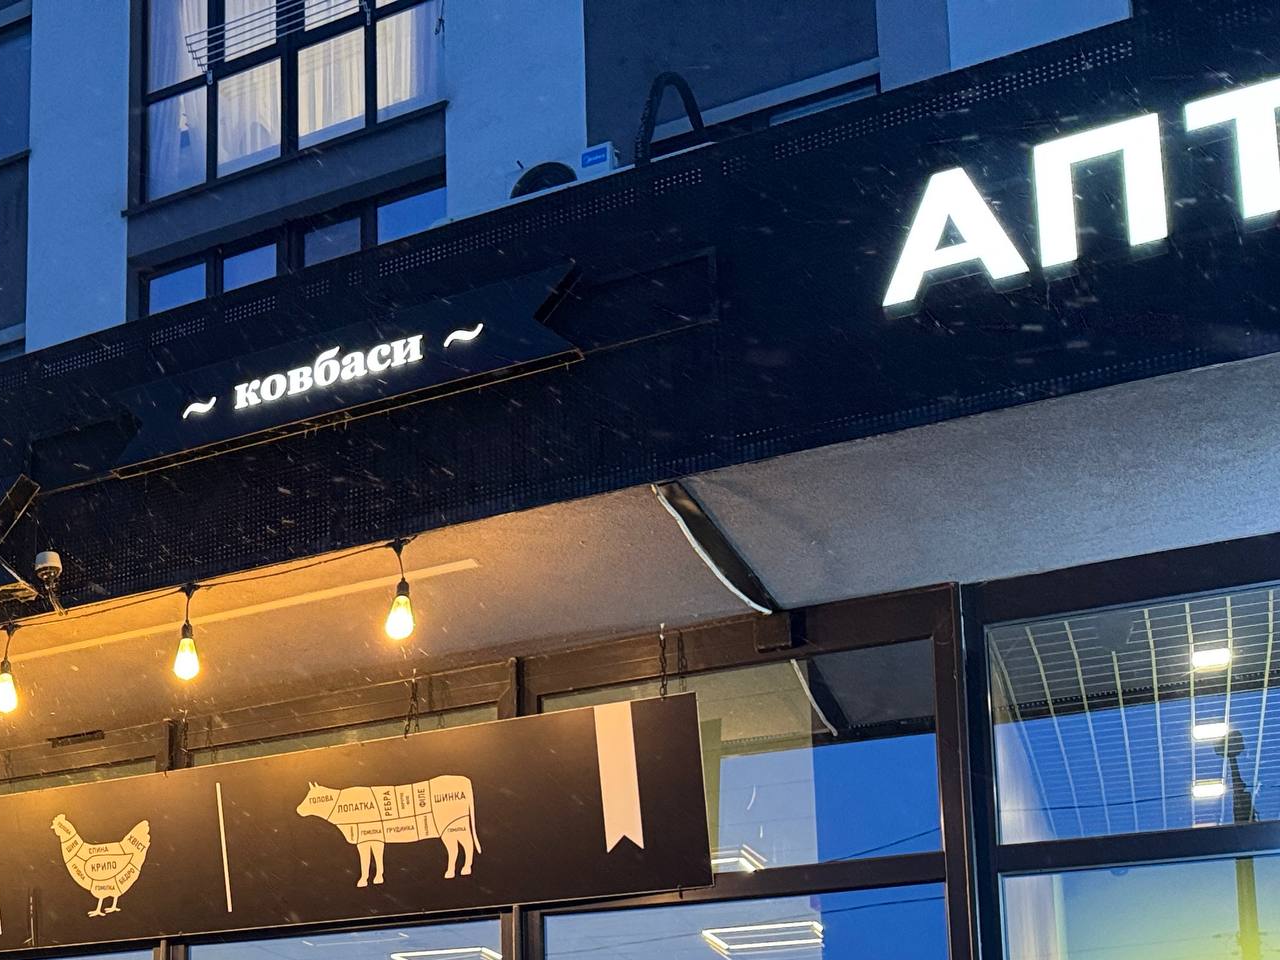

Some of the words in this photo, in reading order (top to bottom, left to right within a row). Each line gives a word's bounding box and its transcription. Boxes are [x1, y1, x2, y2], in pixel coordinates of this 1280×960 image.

[882, 77, 1280, 308] АПТ
[233, 334, 424, 409] ковбаси
[337, 801, 376, 814] ЛОПАТКА
[384, 790, 392, 817] РЕБРА
[433, 791, 466, 804] ШИНКА
[88, 845, 109, 855] СПИНА
